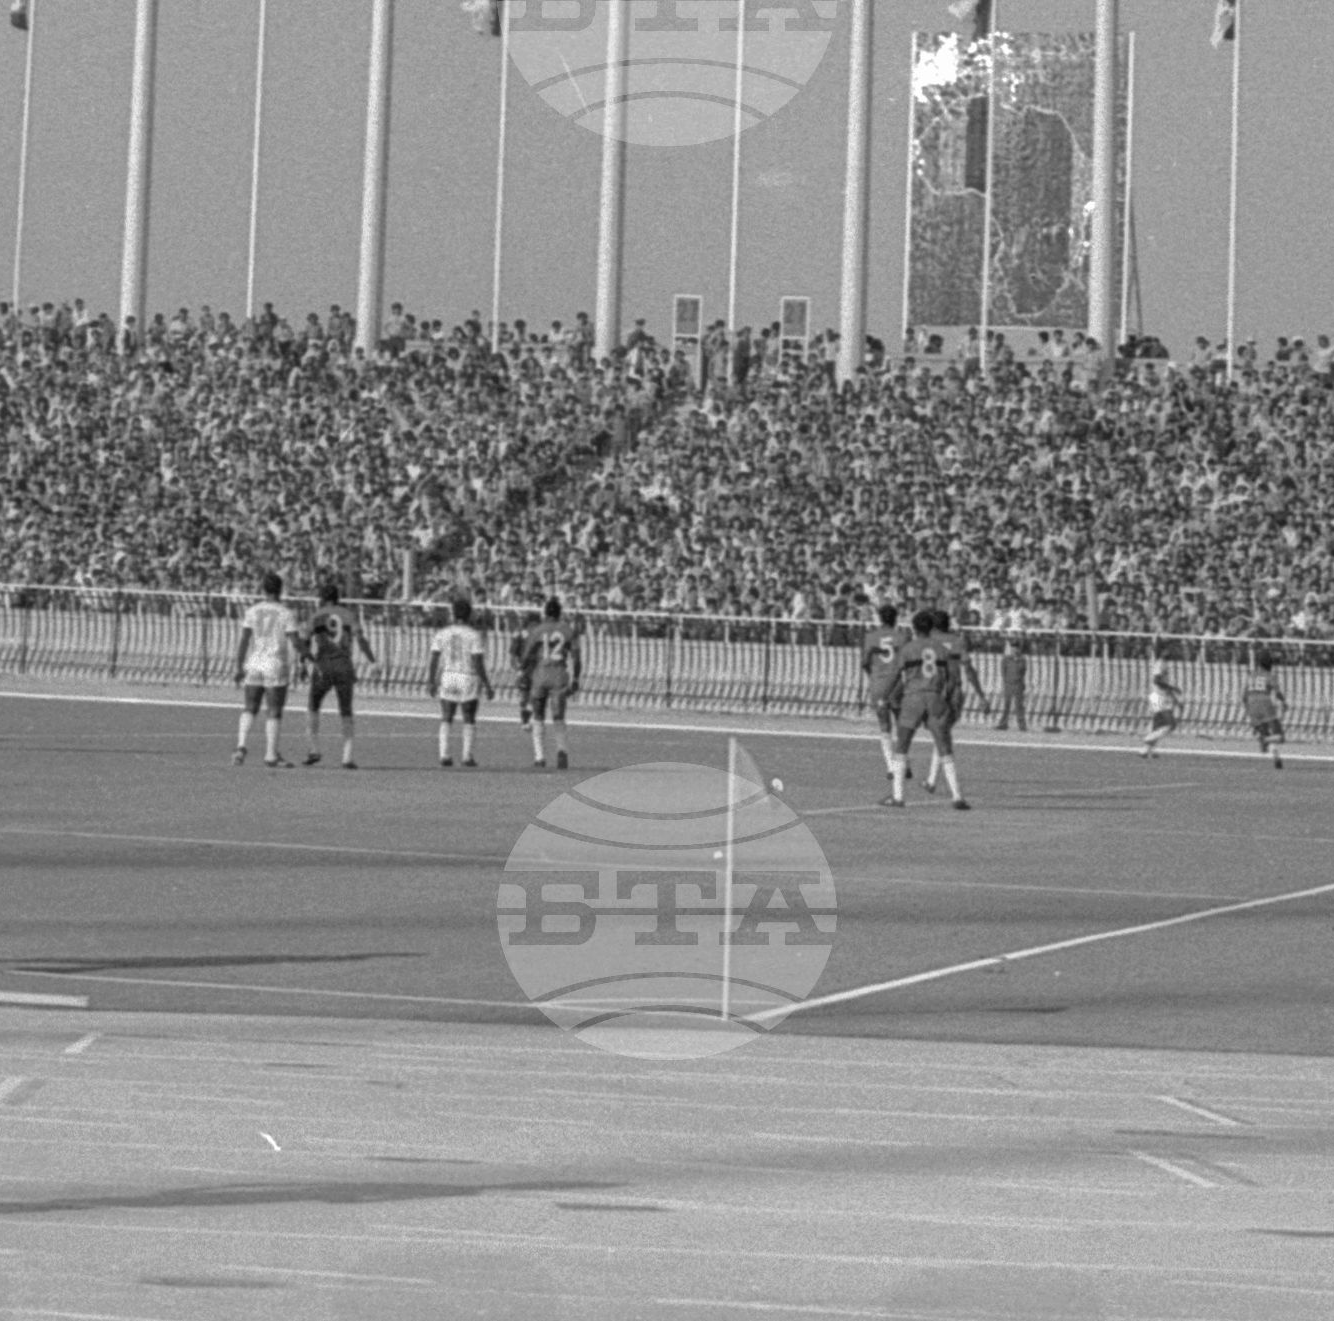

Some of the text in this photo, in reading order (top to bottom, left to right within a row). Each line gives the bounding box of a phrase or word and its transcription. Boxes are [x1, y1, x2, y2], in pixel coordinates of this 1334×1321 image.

[328, 614, 342, 643] 9
[543, 631, 564, 660] 12
[878, 637, 894, 663] 5
[921, 647, 937, 678] 8
